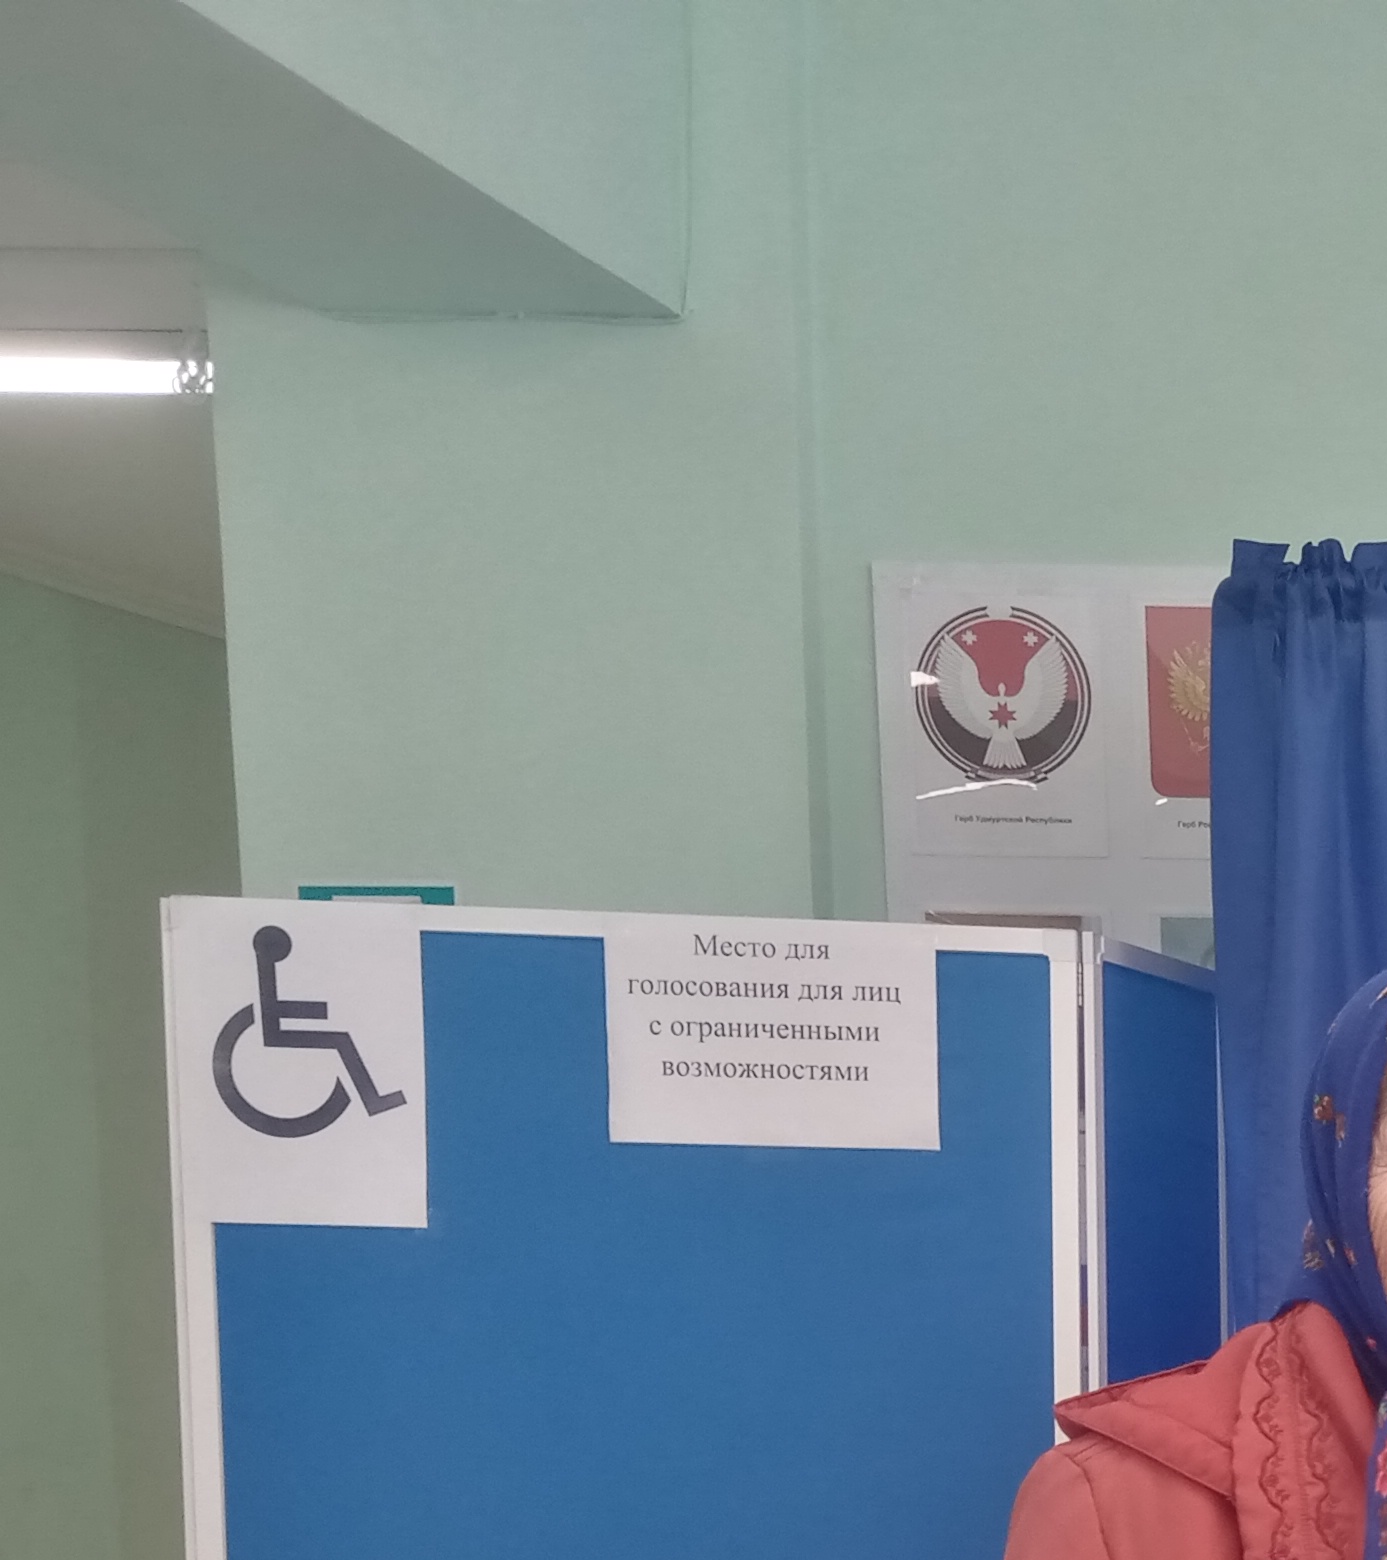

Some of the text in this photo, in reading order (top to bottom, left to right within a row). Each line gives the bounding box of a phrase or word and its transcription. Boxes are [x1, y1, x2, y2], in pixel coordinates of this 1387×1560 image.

[693, 934, 830, 961] Место для
[627, 977, 902, 1005] голосования для лиц
[649, 1019, 880, 1044] с ограниченными
[661, 1059, 869, 1082] возможностями
